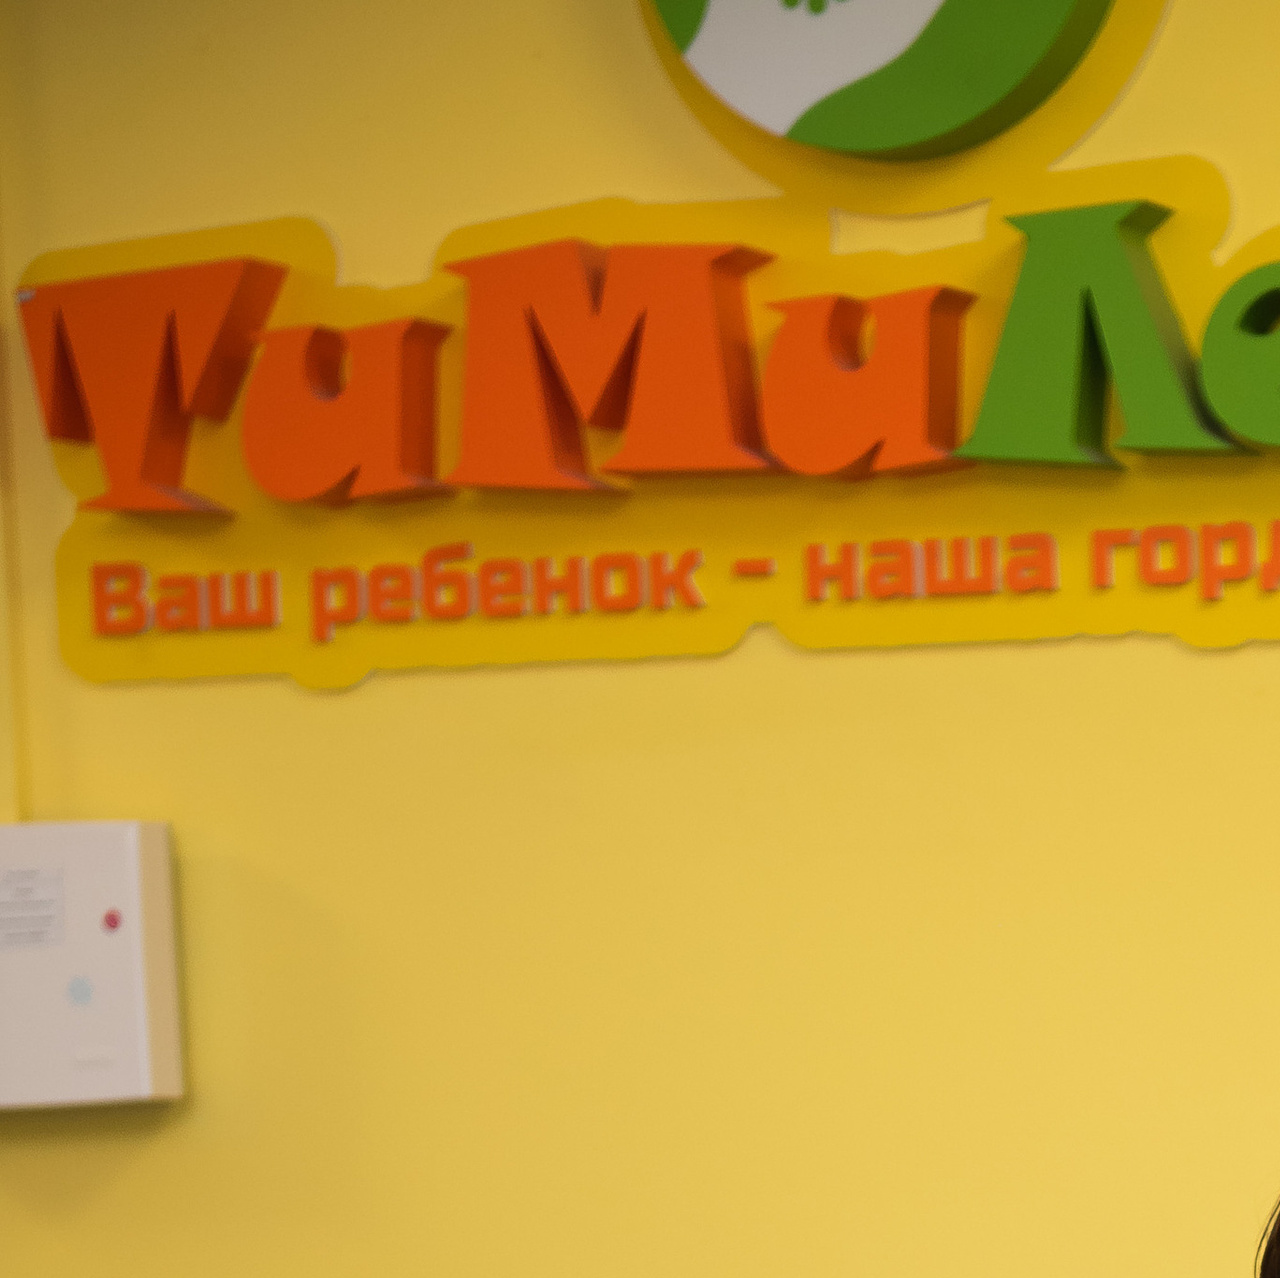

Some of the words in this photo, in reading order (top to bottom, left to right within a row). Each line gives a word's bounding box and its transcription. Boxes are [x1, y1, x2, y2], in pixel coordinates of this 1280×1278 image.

[90, 560, 284, 639] Ваш
[310, 541, 705, 644] ребенок
[804, 531, 1060, 602] наша
